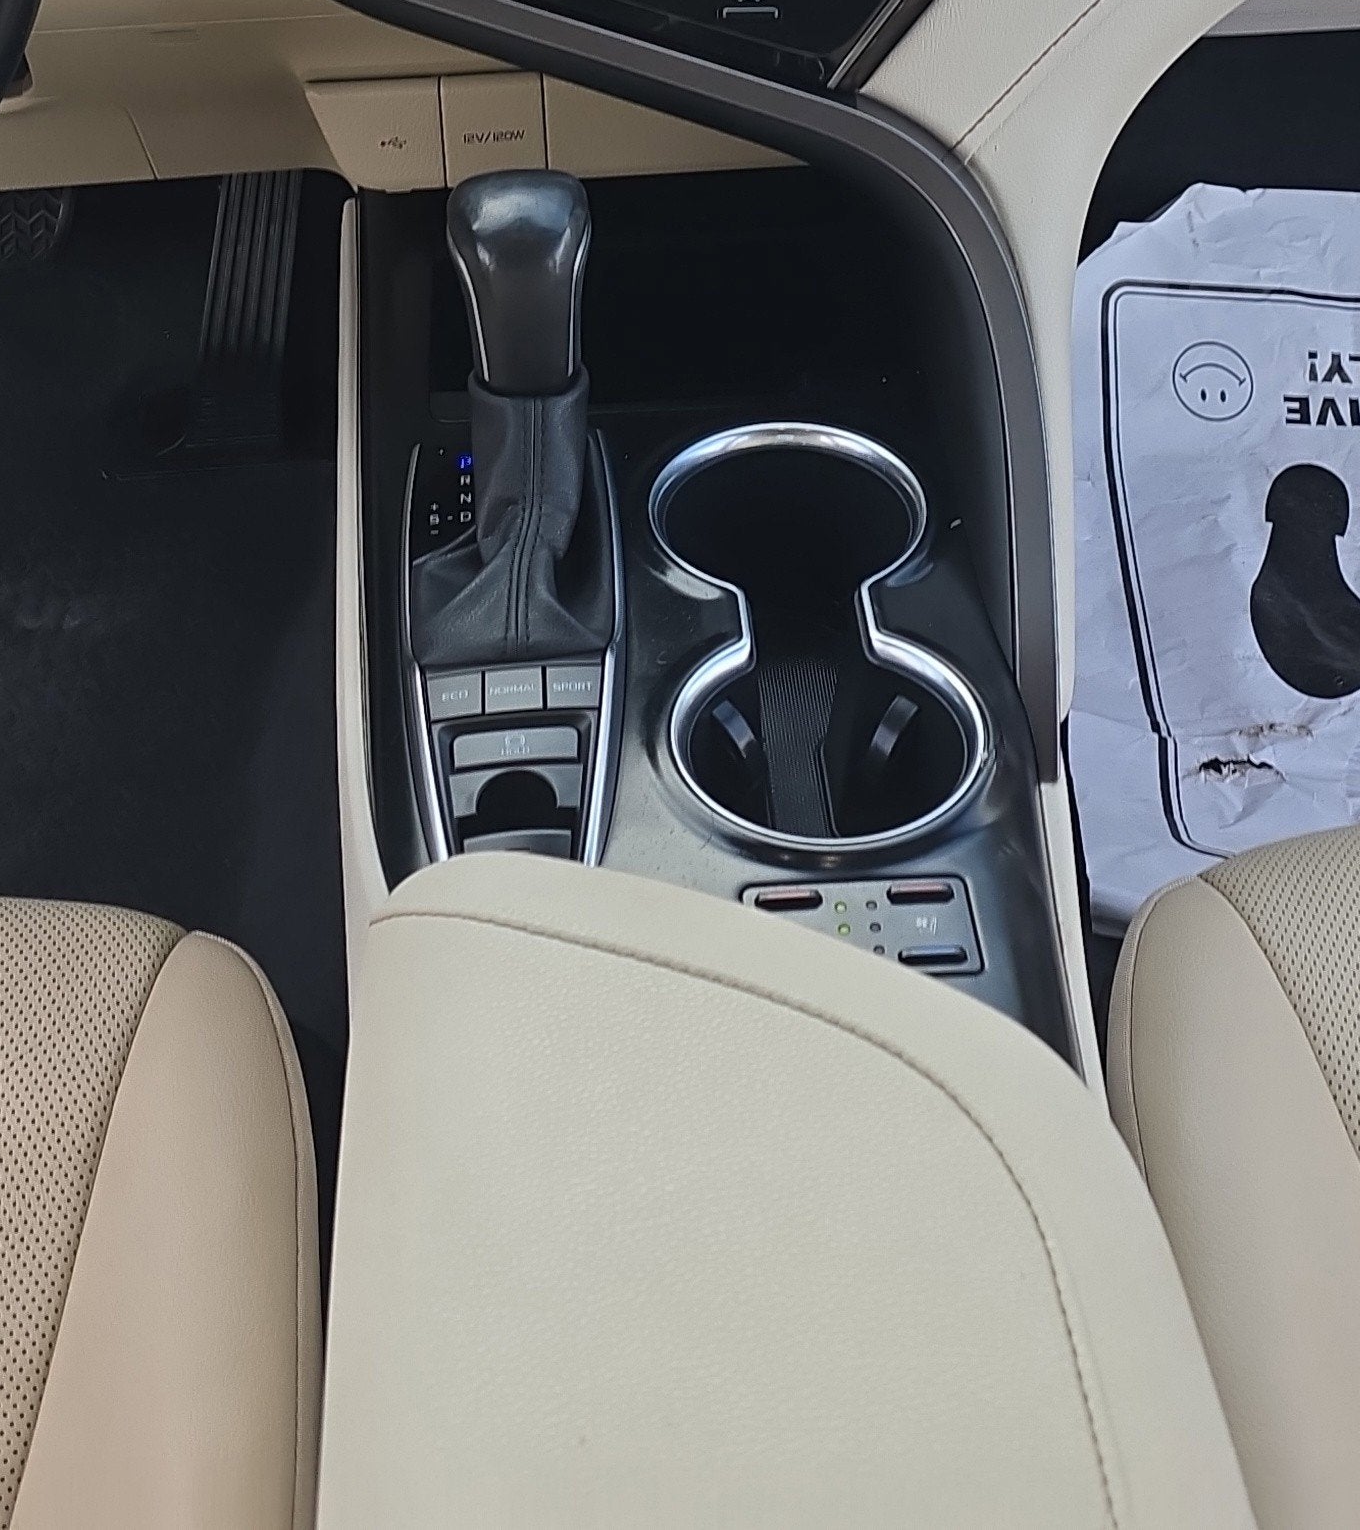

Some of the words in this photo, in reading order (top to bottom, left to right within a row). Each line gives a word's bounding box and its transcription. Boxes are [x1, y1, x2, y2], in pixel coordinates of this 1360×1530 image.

[460, 474, 471, 486] R
[460, 492, 472, 505] N
[460, 511, 472, 523] D
[490, 683, 535, 696] NORMAL
[552, 681, 591, 692] SPORT
